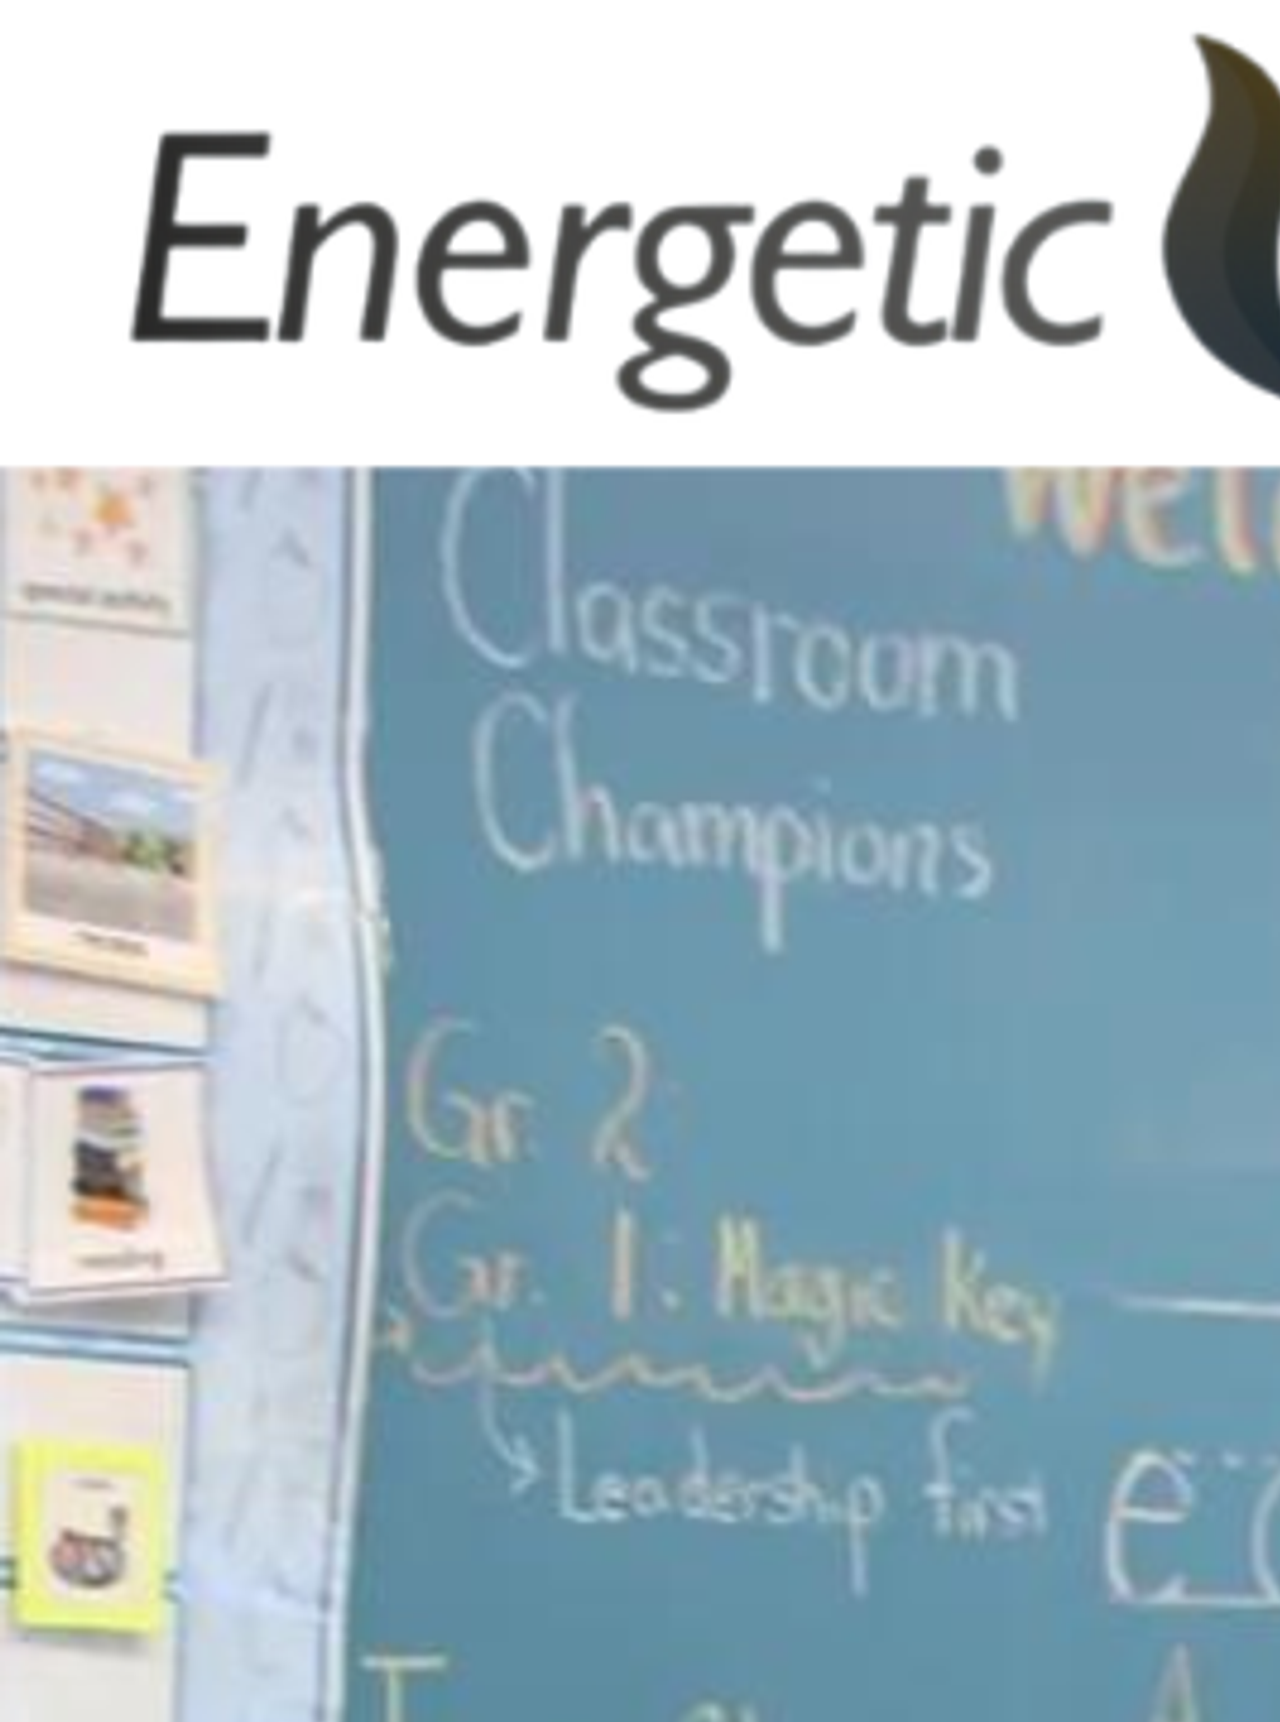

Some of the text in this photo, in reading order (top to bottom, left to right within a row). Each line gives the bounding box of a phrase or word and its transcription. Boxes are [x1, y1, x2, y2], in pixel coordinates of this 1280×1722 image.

[440, 466, 1018, 722] Classroom
[472, 690, 993, 953] Champions
[716, 1211, 897, 1370] Magic
[942, 1224, 1058, 1390] Key
[558, 1405, 1048, 1598] Leadership first
